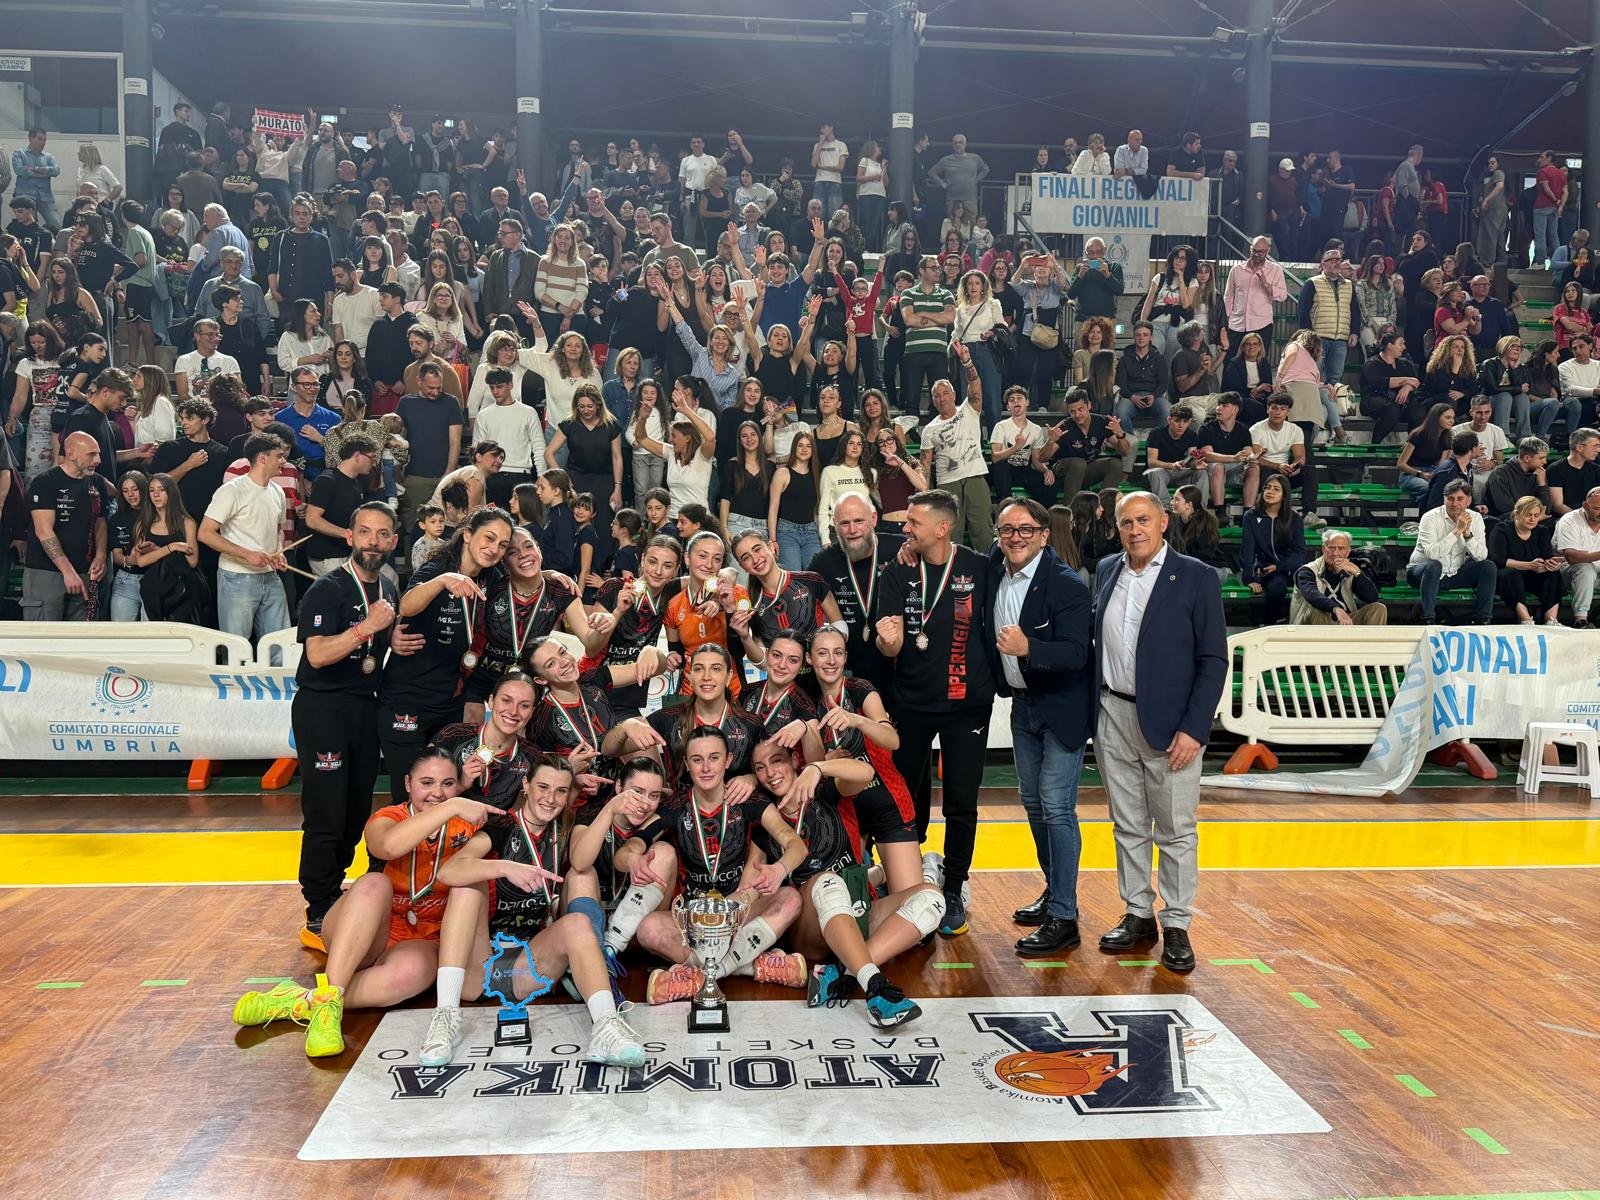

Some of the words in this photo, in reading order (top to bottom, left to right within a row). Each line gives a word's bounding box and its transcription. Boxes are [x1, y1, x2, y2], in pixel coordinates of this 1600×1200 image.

[258, 116, 302, 131] MURATO
[1038, 176, 1096, 200] FINALI
[1101, 178, 1193, 202] REGNALI
[1072, 204, 1159, 228] GIOVANILI
[698, 622, 706, 638] 9
[208, 673, 300, 701] FINA
[1567, 704, 1600, 713] COMITA
[49, 723, 109, 735] COMITATO
[111, 724, 180, 736] REGIONALE
[52, 738, 181, 753] UMBRIA
[377, 1040, 669, 1061] SOLEO
[706, 1036, 940, 1052] BASKET
[386, 1052, 946, 1101] ATOMIKA
[999, 1088, 1064, 1104] Atomika
